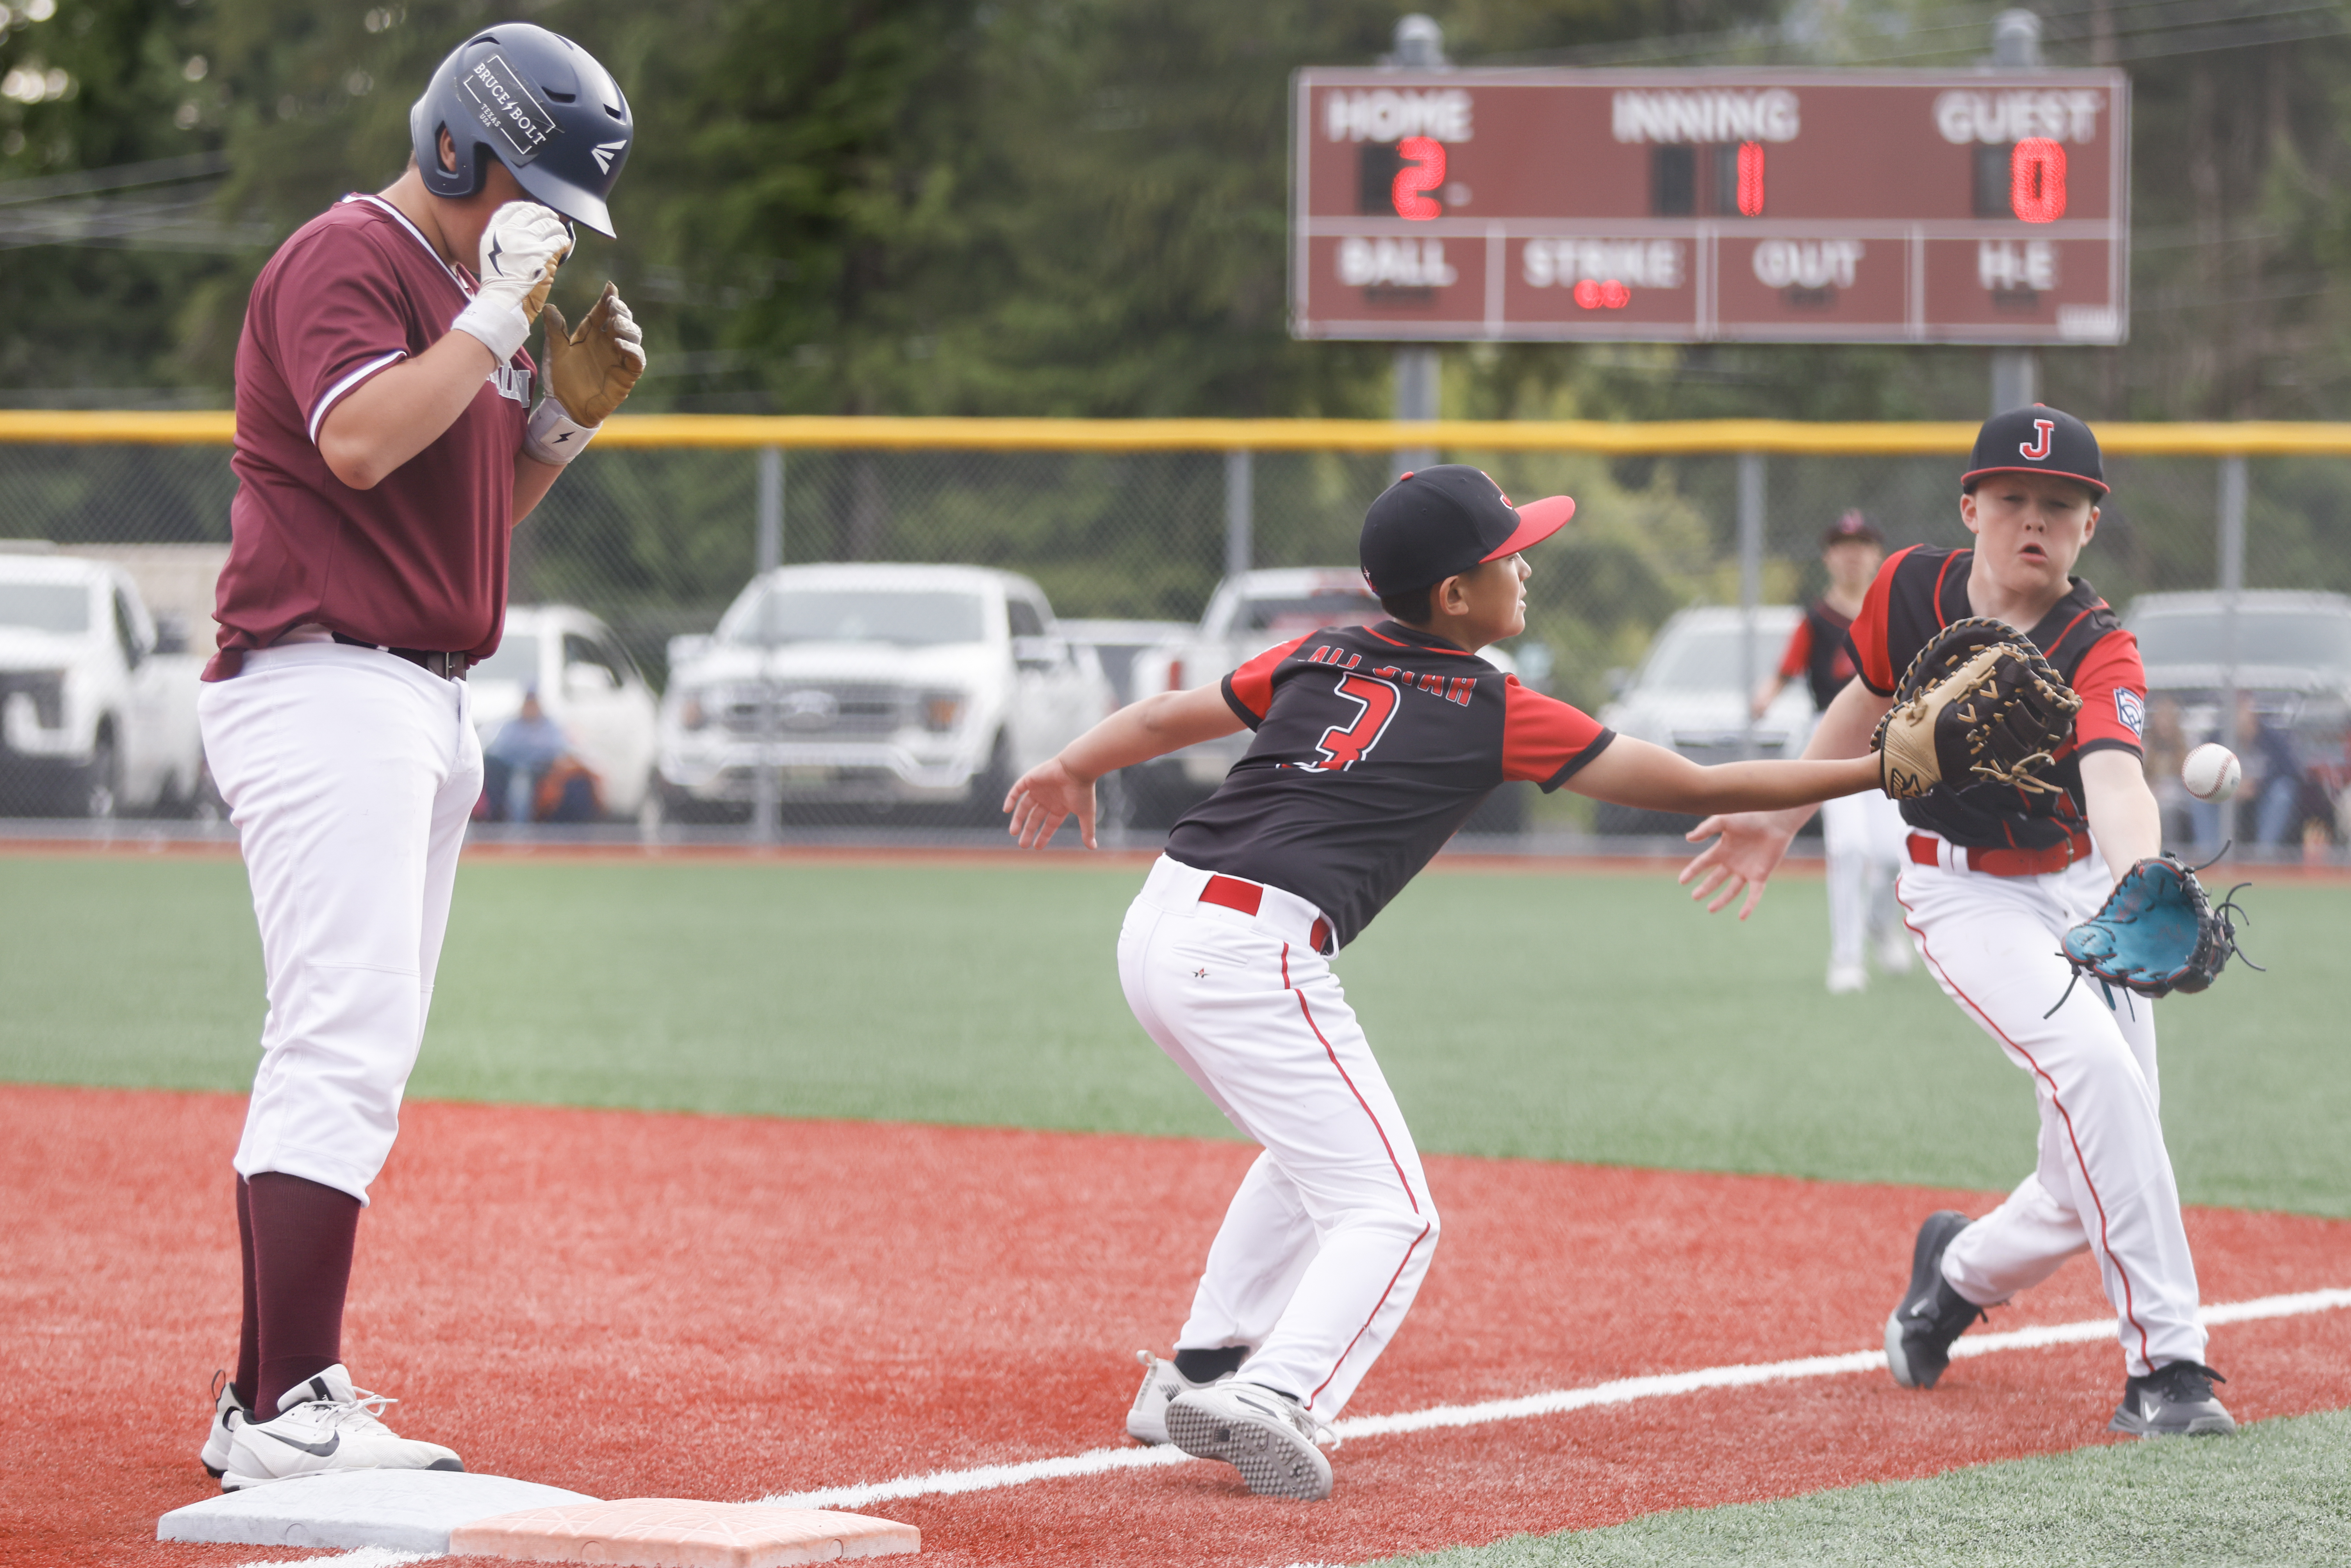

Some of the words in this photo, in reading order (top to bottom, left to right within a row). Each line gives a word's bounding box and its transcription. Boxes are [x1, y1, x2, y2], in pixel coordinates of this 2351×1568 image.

[474, 62, 510, 105] BRUCE
[510, 107, 546, 145] BOLT
[480, 114, 491, 127] USA
[481, 103, 501, 127] TEXAS
[1325, 90, 1474, 142] HOME
[1612, 89, 1800, 143] INNING
[1934, 90, 2105, 144] GUEST
[1391, 136, 1447, 221] 2
[1737, 141, 1765, 217] 1
[2010, 137, 2067, 223] 0
[1337, 237, 1457, 286] BALL
[1523, 238, 1684, 288] STRIKE
[1752, 239, 1864, 288] OUT
[2019, 419, 2055, 461] J
